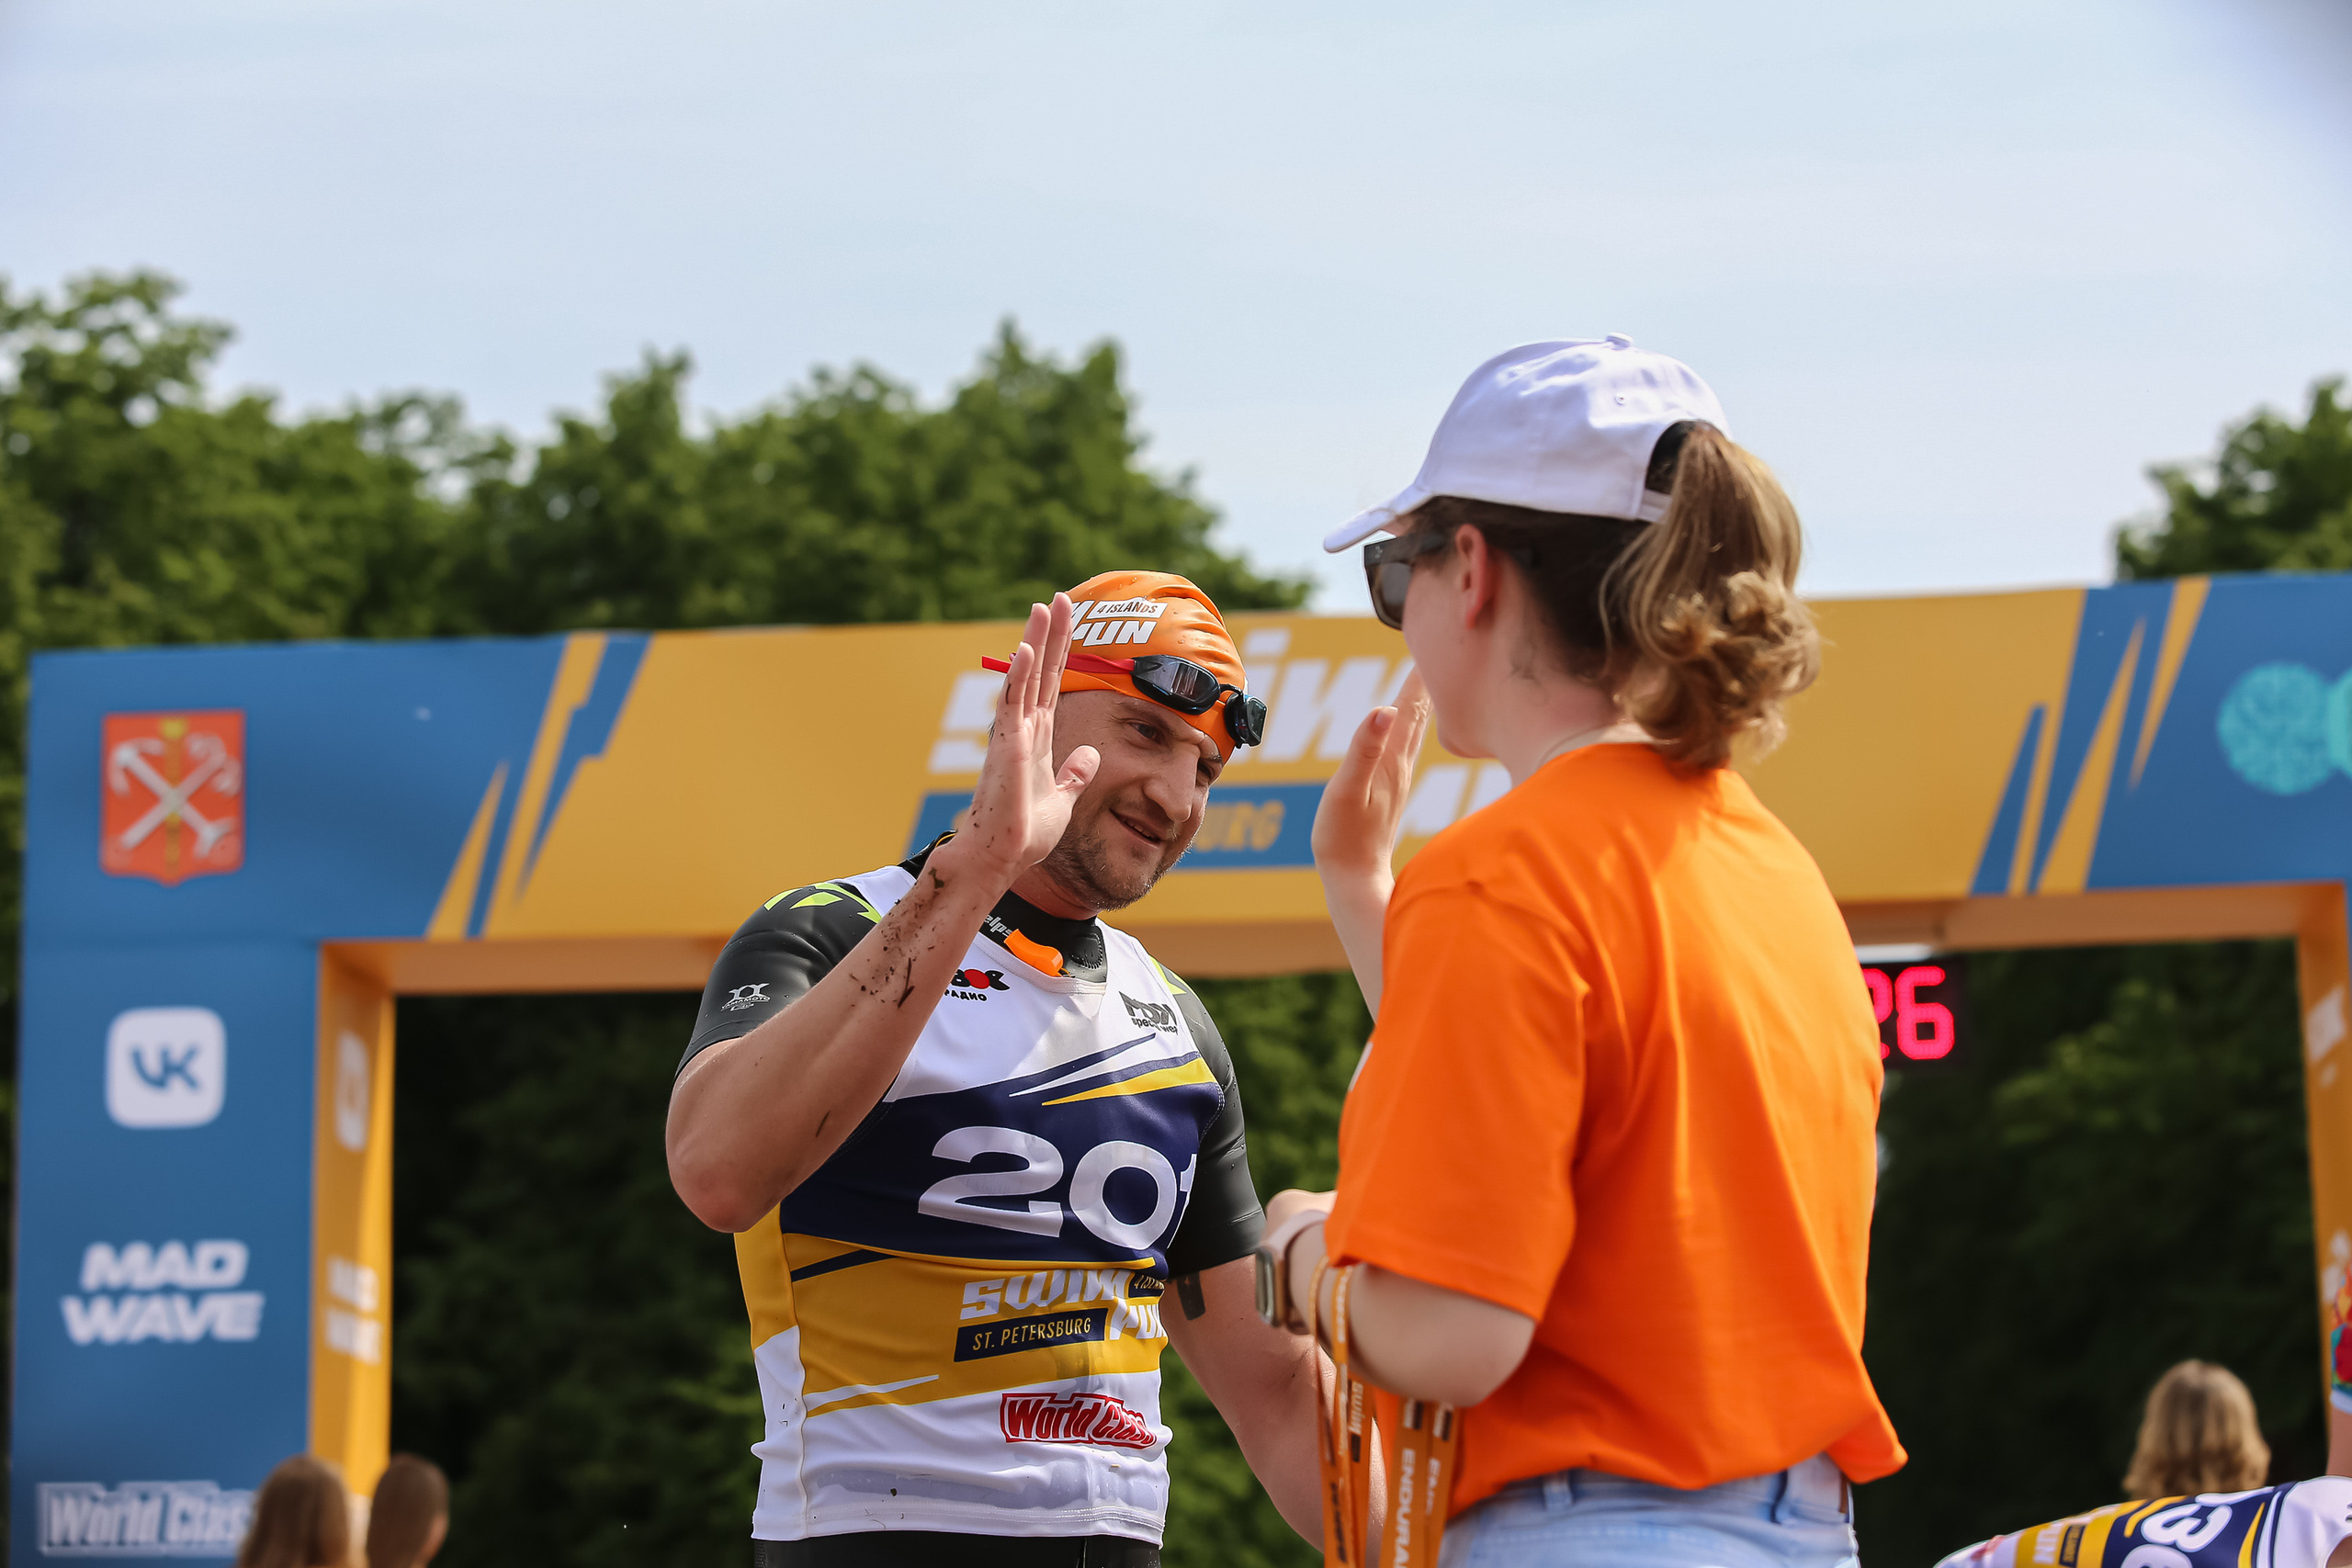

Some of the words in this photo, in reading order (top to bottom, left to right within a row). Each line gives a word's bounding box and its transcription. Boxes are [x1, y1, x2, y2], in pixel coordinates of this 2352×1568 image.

[1097, 604, 1108, 615] 4
[1106, 602, 1159, 614] ISLANDS
[130, 1045, 199, 1092] VK
[81, 1240, 249, 1292] MAD
[61, 1292, 265, 1345] WAVE
[959, 1269, 1135, 1320] SWIM
[972, 1331, 995, 1350] ST.
[1001, 1317, 1091, 1345] PETERSBURG
[1007, 1398, 1102, 1439] World
[48, 1490, 165, 1547] World
[165, 1492, 260, 1547] Clas
[1394, 1449, 1416, 1568] ENDURA
